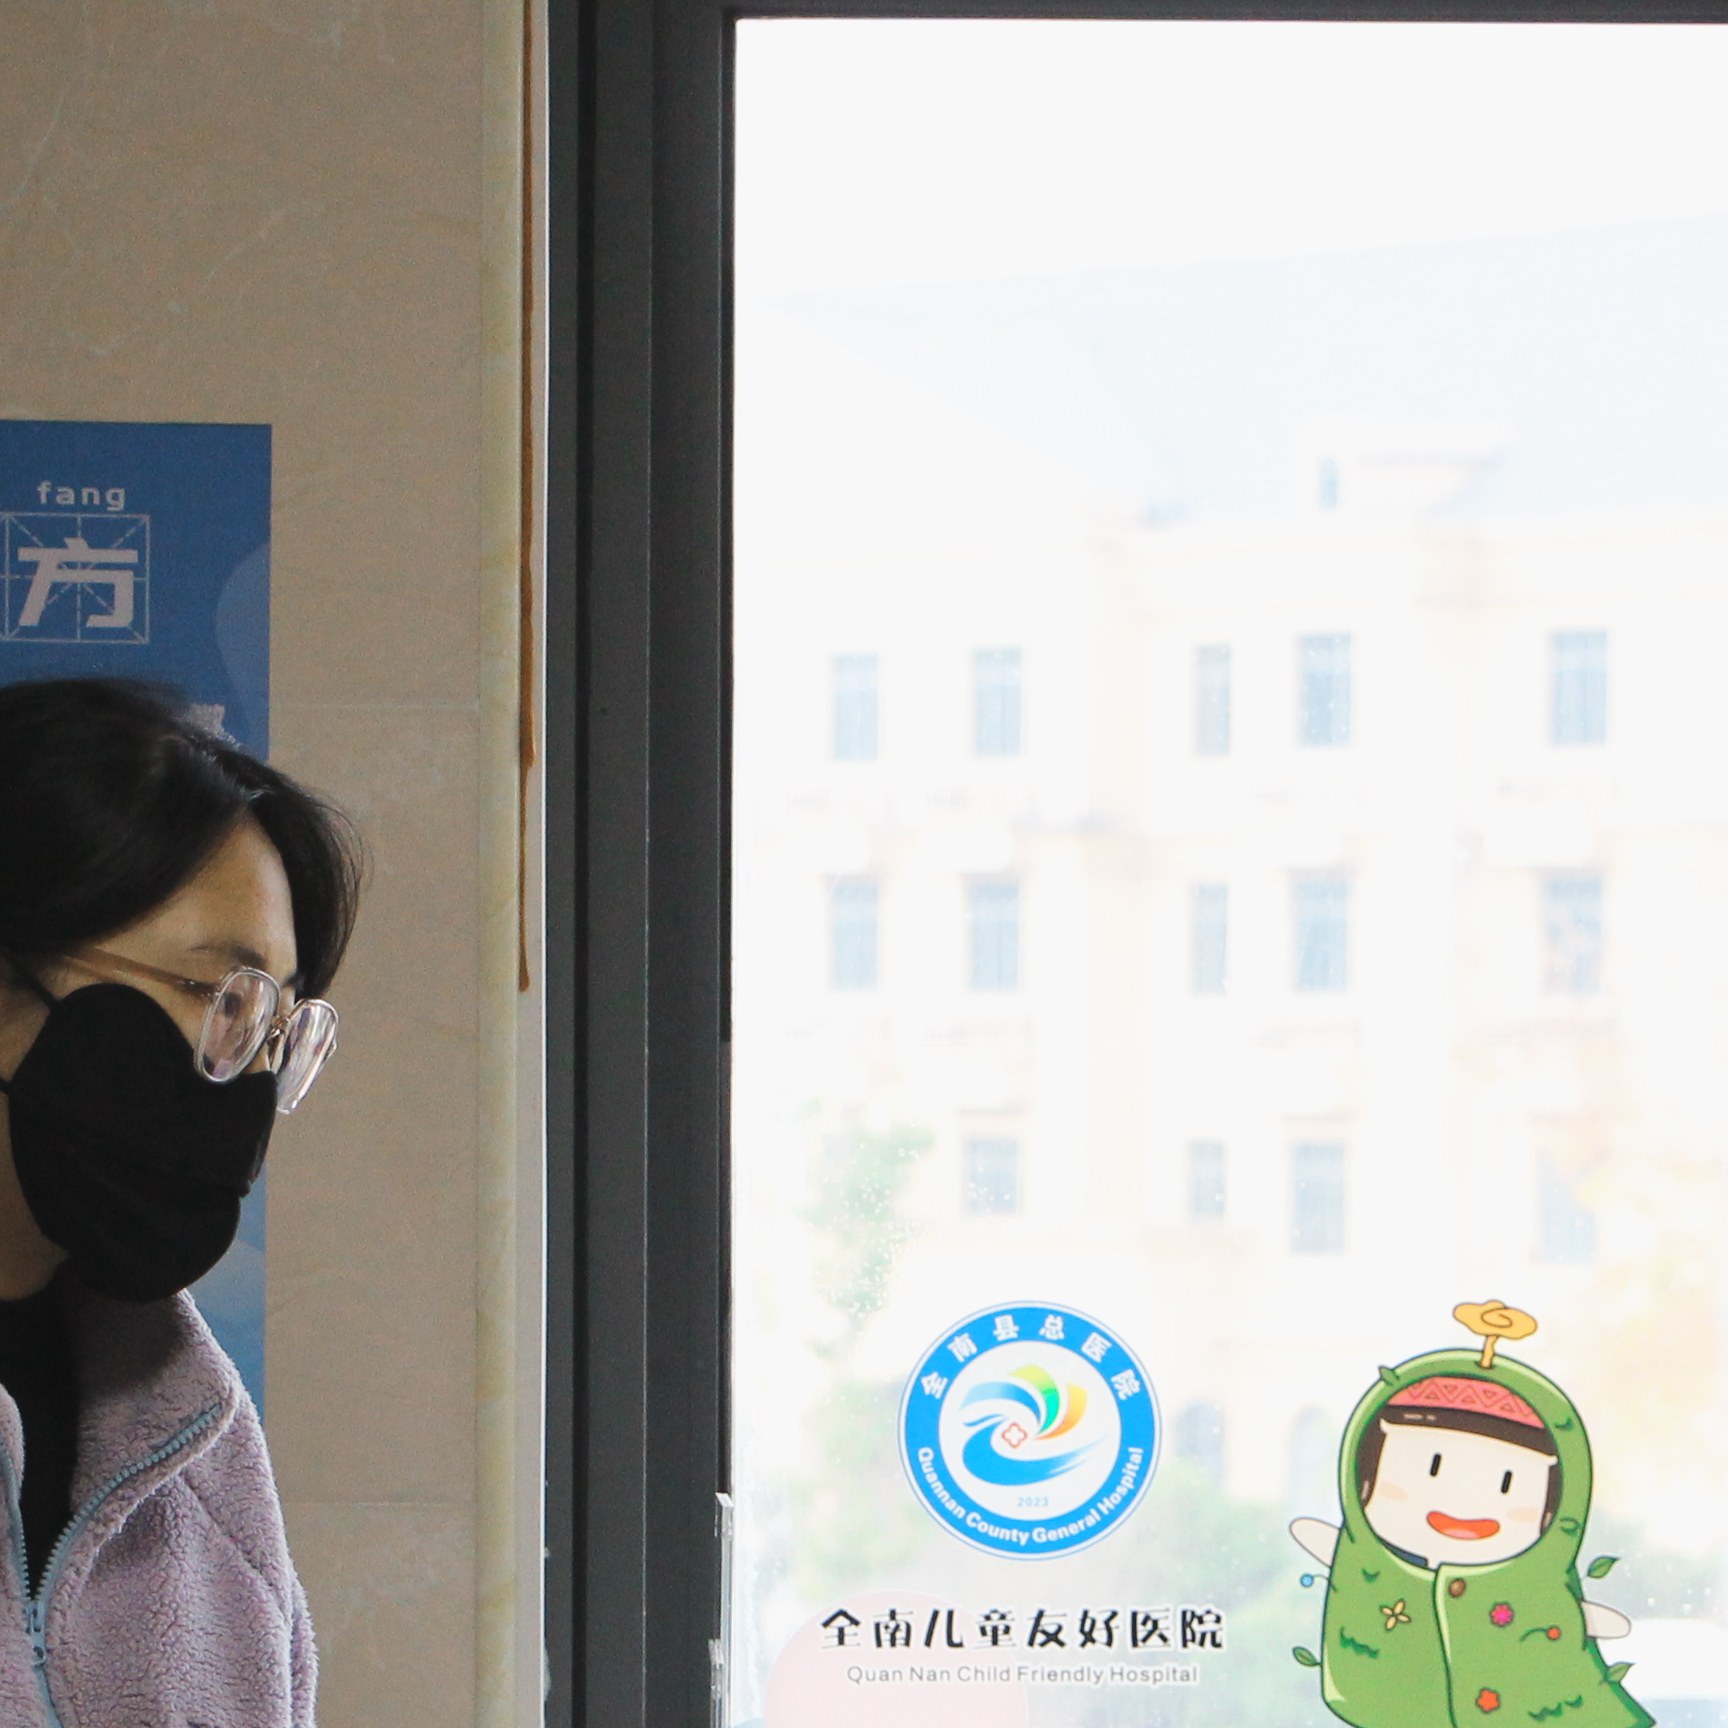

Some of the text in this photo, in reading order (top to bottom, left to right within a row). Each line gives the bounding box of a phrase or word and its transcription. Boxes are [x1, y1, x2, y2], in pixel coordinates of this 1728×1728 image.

[37, 481, 127, 511] fang
[920, 1314, 1141, 1400] 全南县总医院
[917, 1446, 1144, 1546] Quannan County General Hospital
[1017, 1496, 1049, 1508] 2023
[820, 1608, 1225, 1650] 全南儿童友好医院
[847, 1666, 1197, 1686] Quan Nan Child Friendly Hospital
